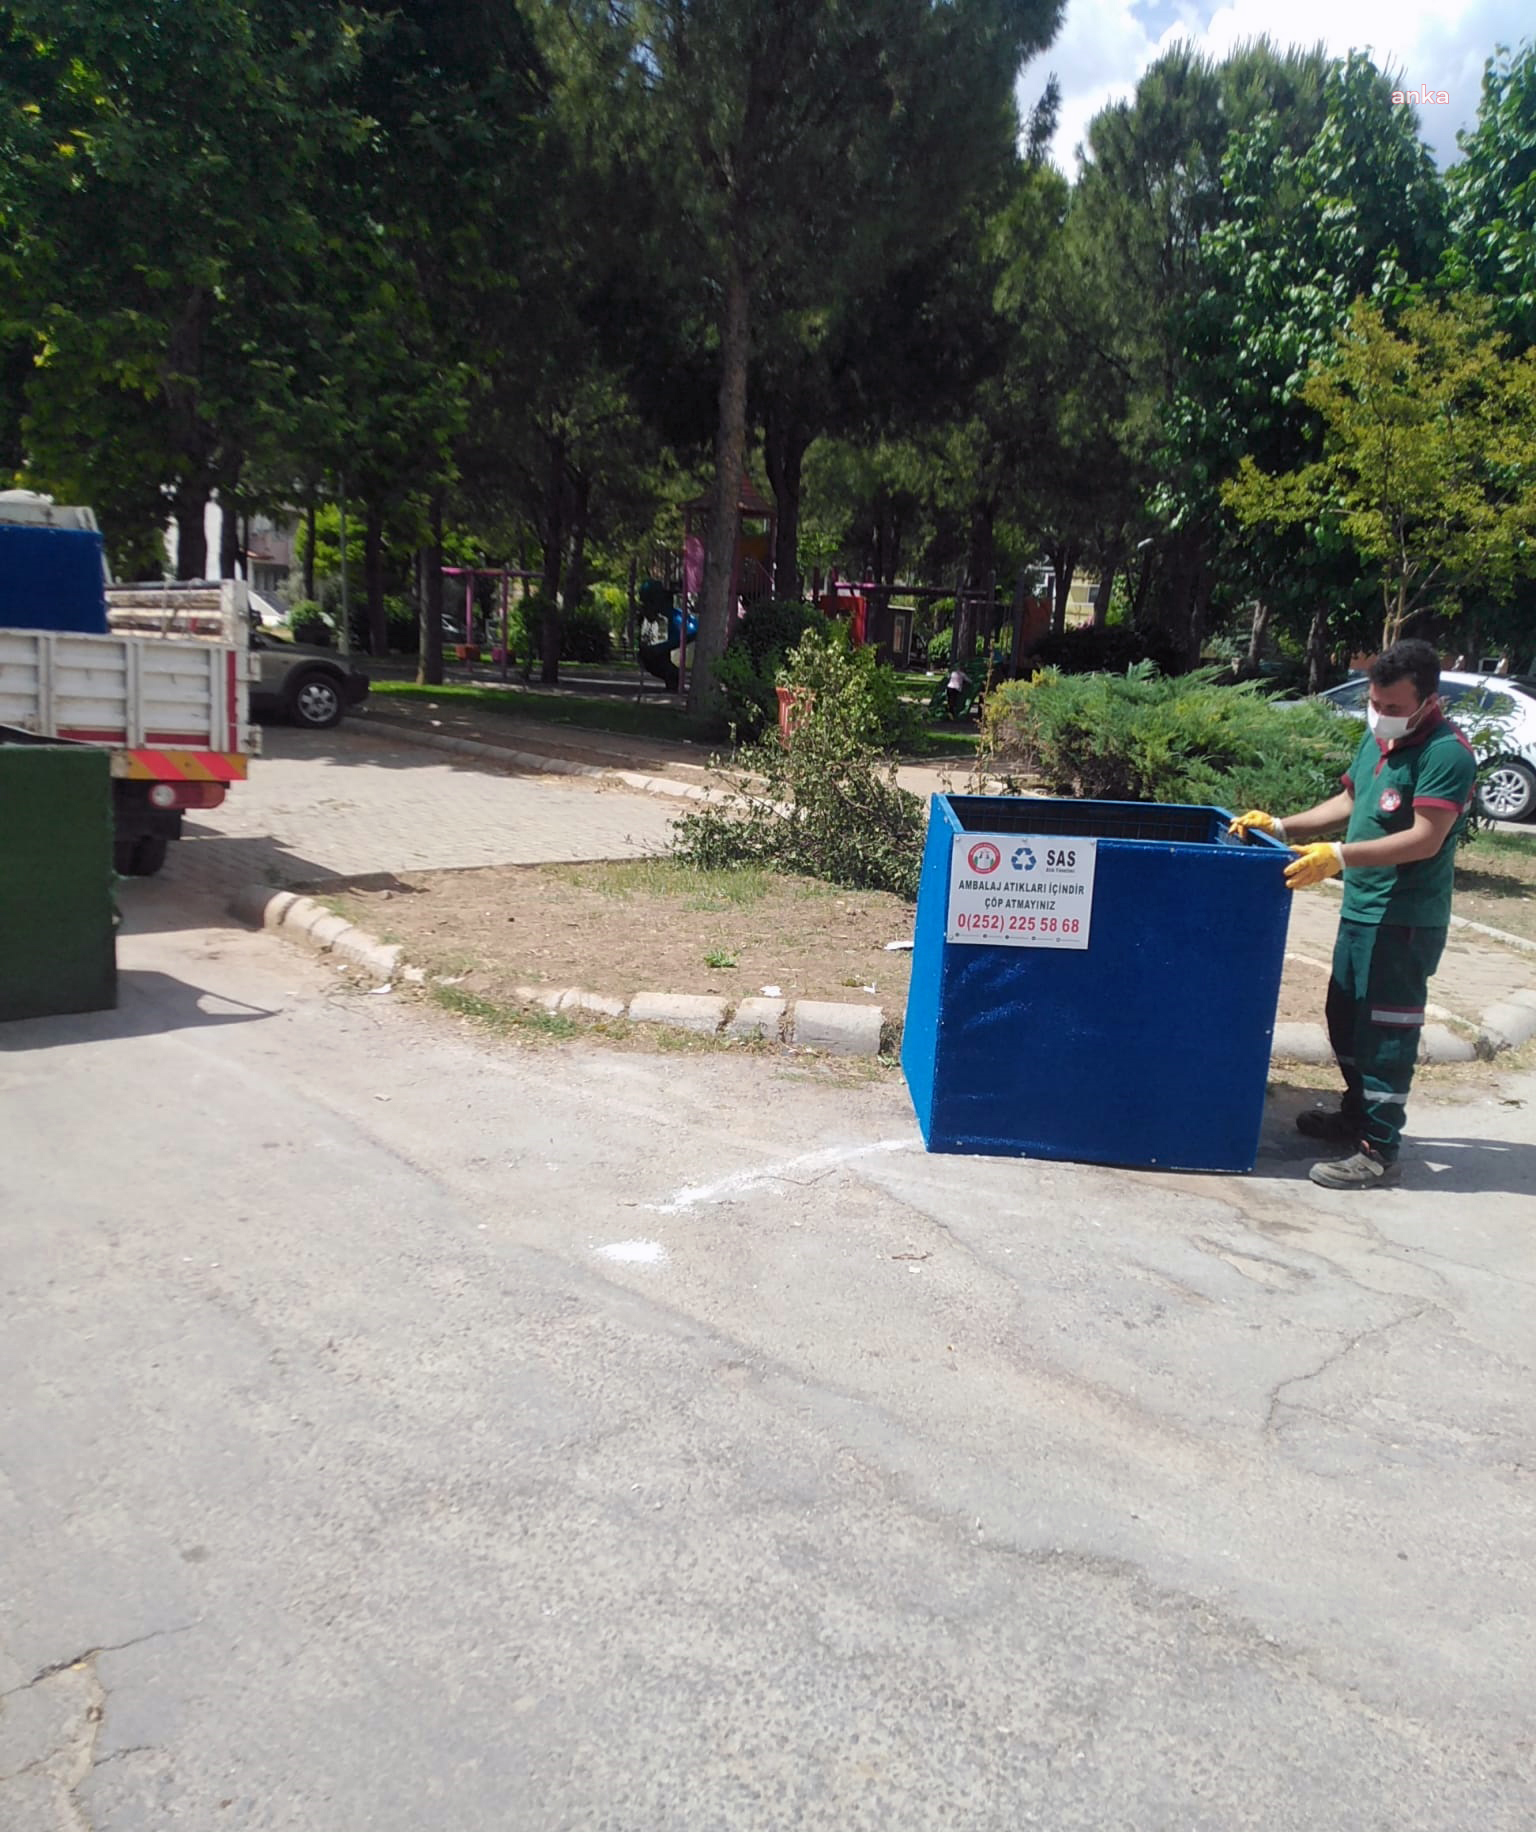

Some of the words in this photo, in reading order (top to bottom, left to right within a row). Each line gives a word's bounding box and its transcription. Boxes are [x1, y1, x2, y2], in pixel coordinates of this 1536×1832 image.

[1046, 849, 1076, 867] SAS
[958, 880, 1001, 891] AMBALAJ
[1004, 881, 1046, 893] ATIKLARI
[1049, 882, 1085, 896] İÇİNDİR
[984, 897, 1003, 910] ÇÖP
[1005, 899, 1055, 911] ATMAYINIZ
[957, 913, 1004, 932] 0(252)
[1009, 916, 1035, 931] 225
[1040, 917, 1057, 932] 58
[1062, 918, 1079, 933] 68
